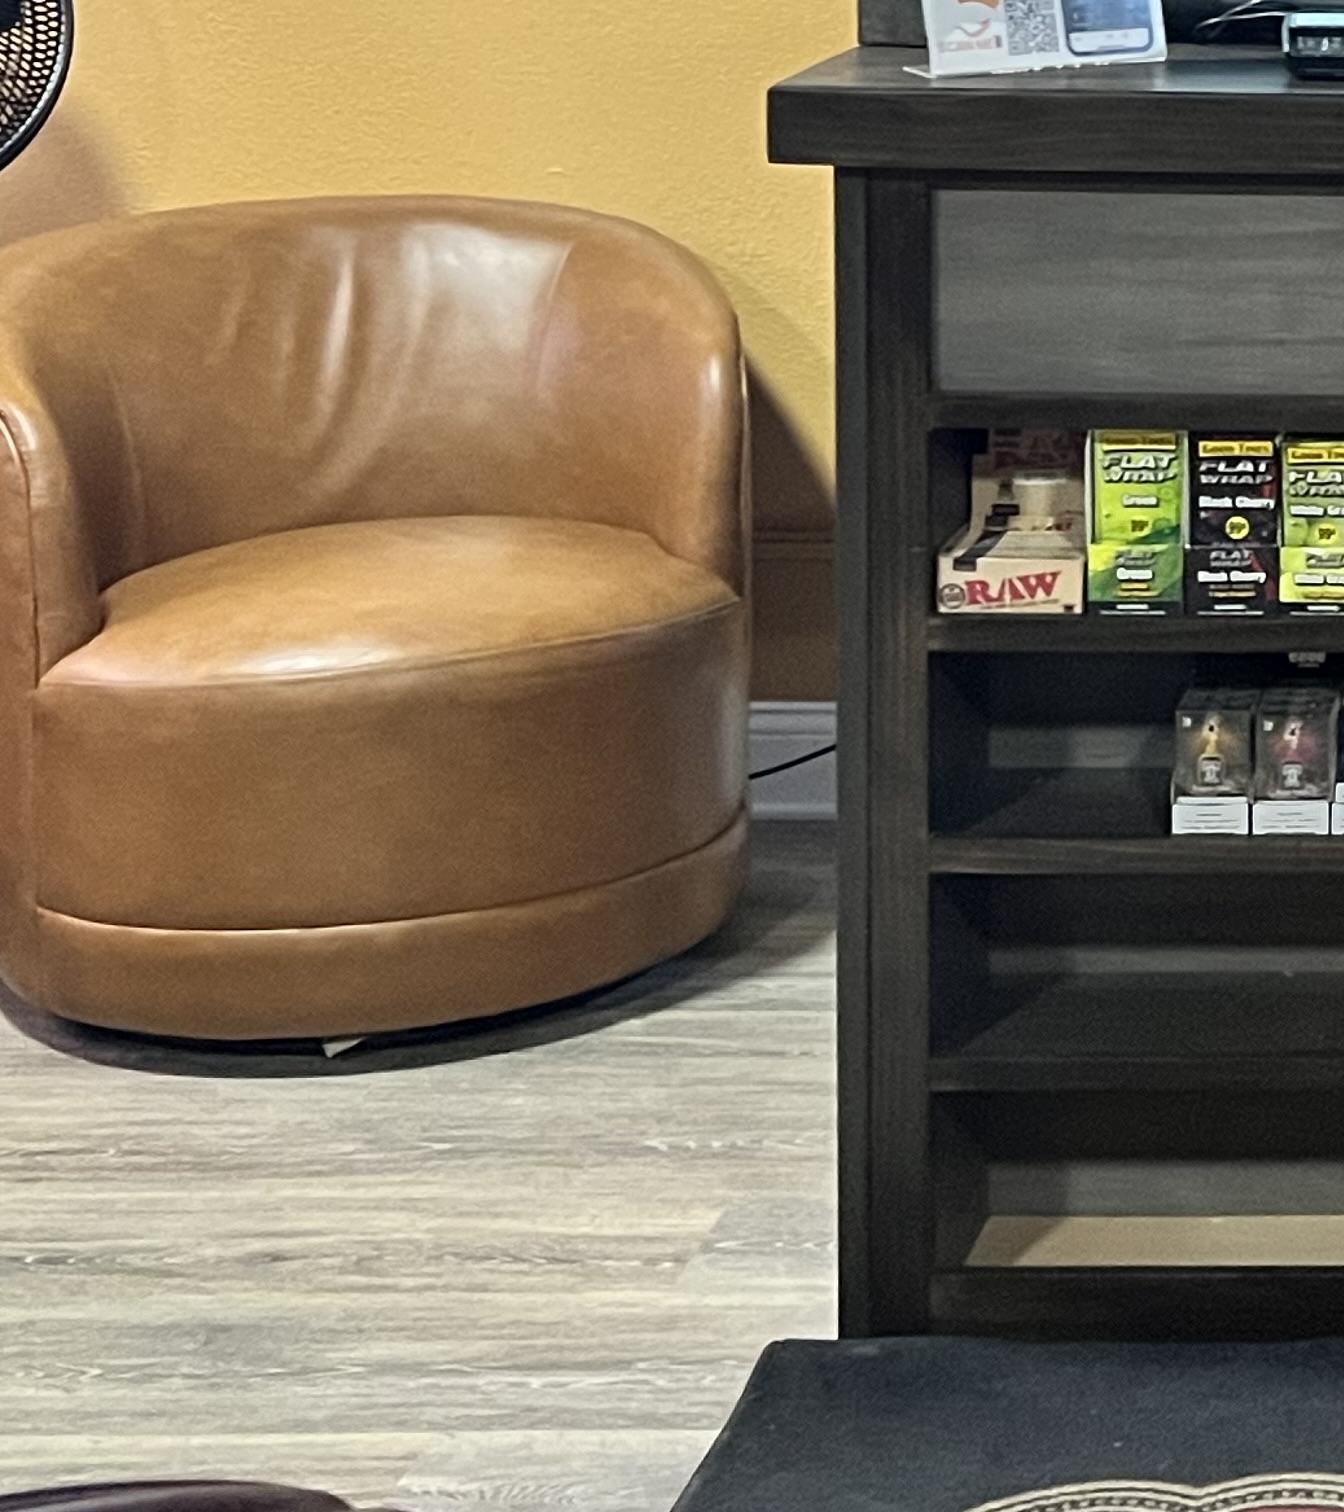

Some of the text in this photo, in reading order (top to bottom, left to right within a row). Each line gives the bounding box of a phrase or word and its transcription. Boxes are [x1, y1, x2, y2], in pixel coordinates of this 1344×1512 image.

[1103, 452, 1178, 470] FLAT
[1200, 459, 1273, 473] FLAT
[1104, 470, 1178, 484] WRAP
[1200, 474, 1273, 484] WRAP
[1199, 495, 1275, 510] Black Cherry
[1210, 550, 1252, 560] FLAT
[1230, 571, 1266, 584] Cherry
[964, 571, 1062, 606] RAW
